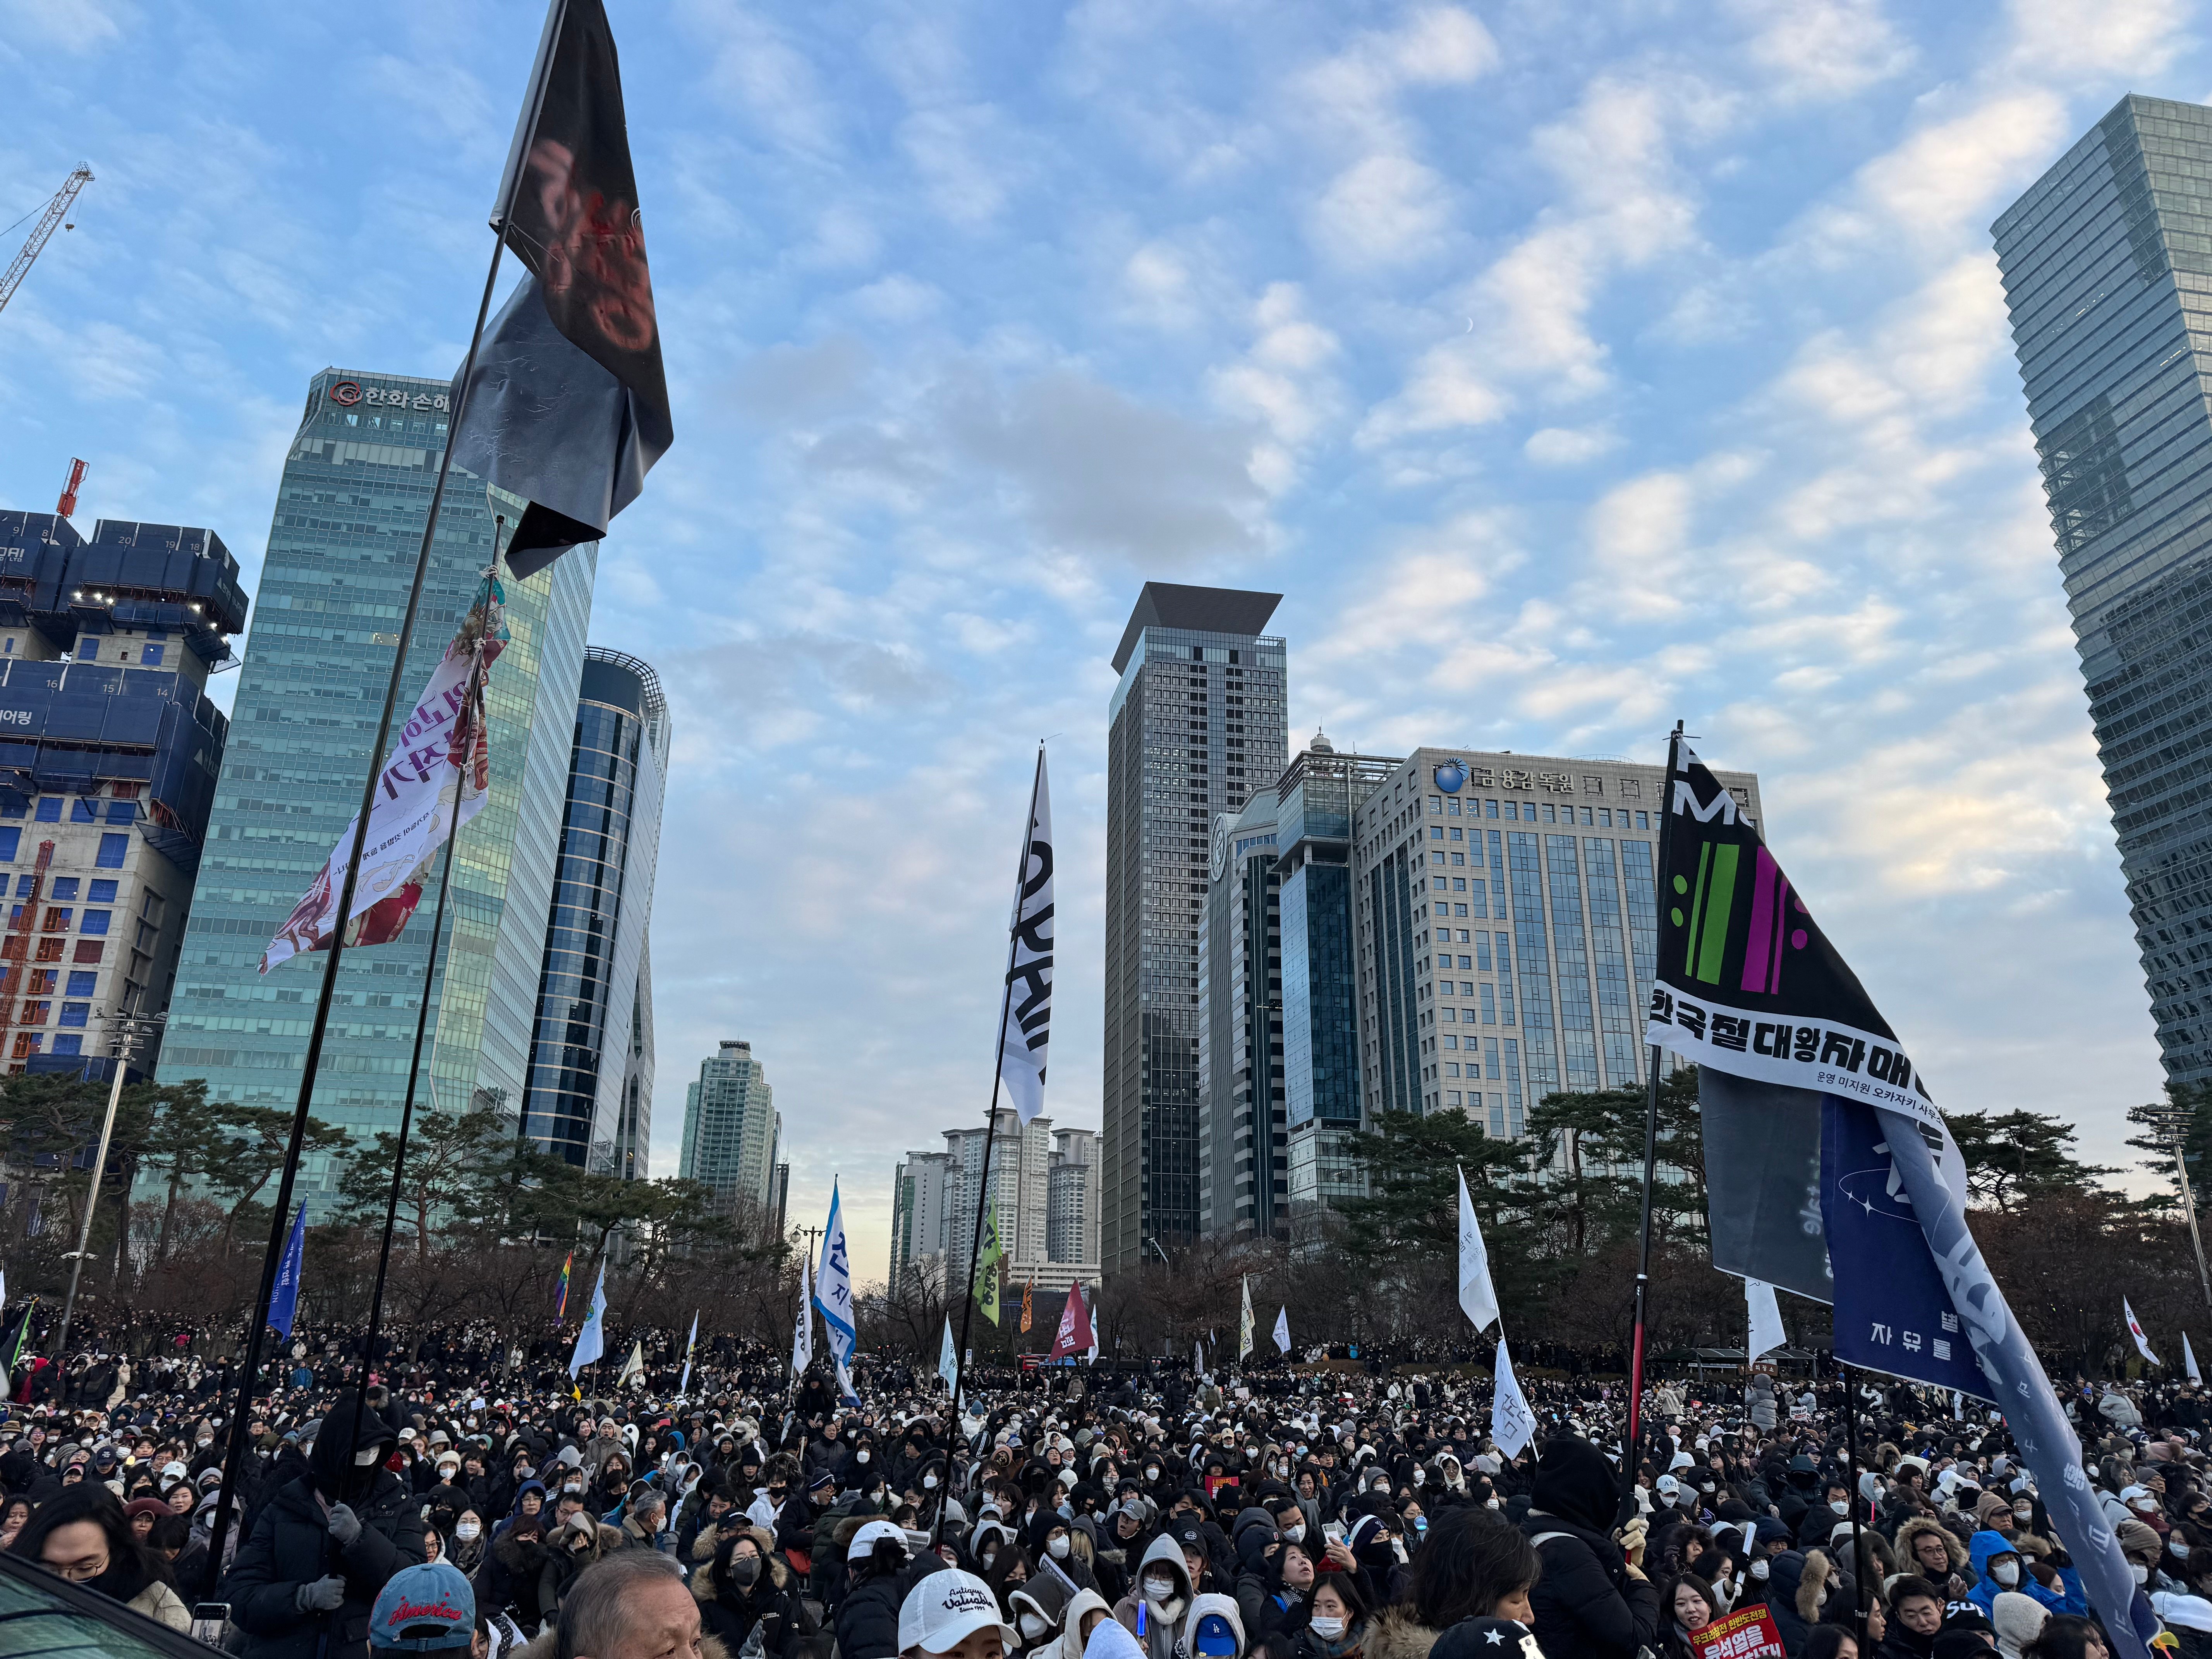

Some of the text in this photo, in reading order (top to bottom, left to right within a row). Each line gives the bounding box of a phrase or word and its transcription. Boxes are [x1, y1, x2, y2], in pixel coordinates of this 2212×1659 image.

[118, 536, 131, 544] 20
[46, 679, 58, 689] 16
[102, 684, 115, 693] 15
[156, 688, 168, 697] 14
[1480, 767, 1575, 793] 금융감독원
[1817, 1072, 1944, 1127] 운영 미지원 오카자키 사무소
[388, 1601, 463, 1626] America
[1213, 1623, 1220, 1633] LA
[1693, 1608, 1767, 1645] 우크라참전 한반도전쟁
[1704, 1625, 1765, 1659] 윤석열을
